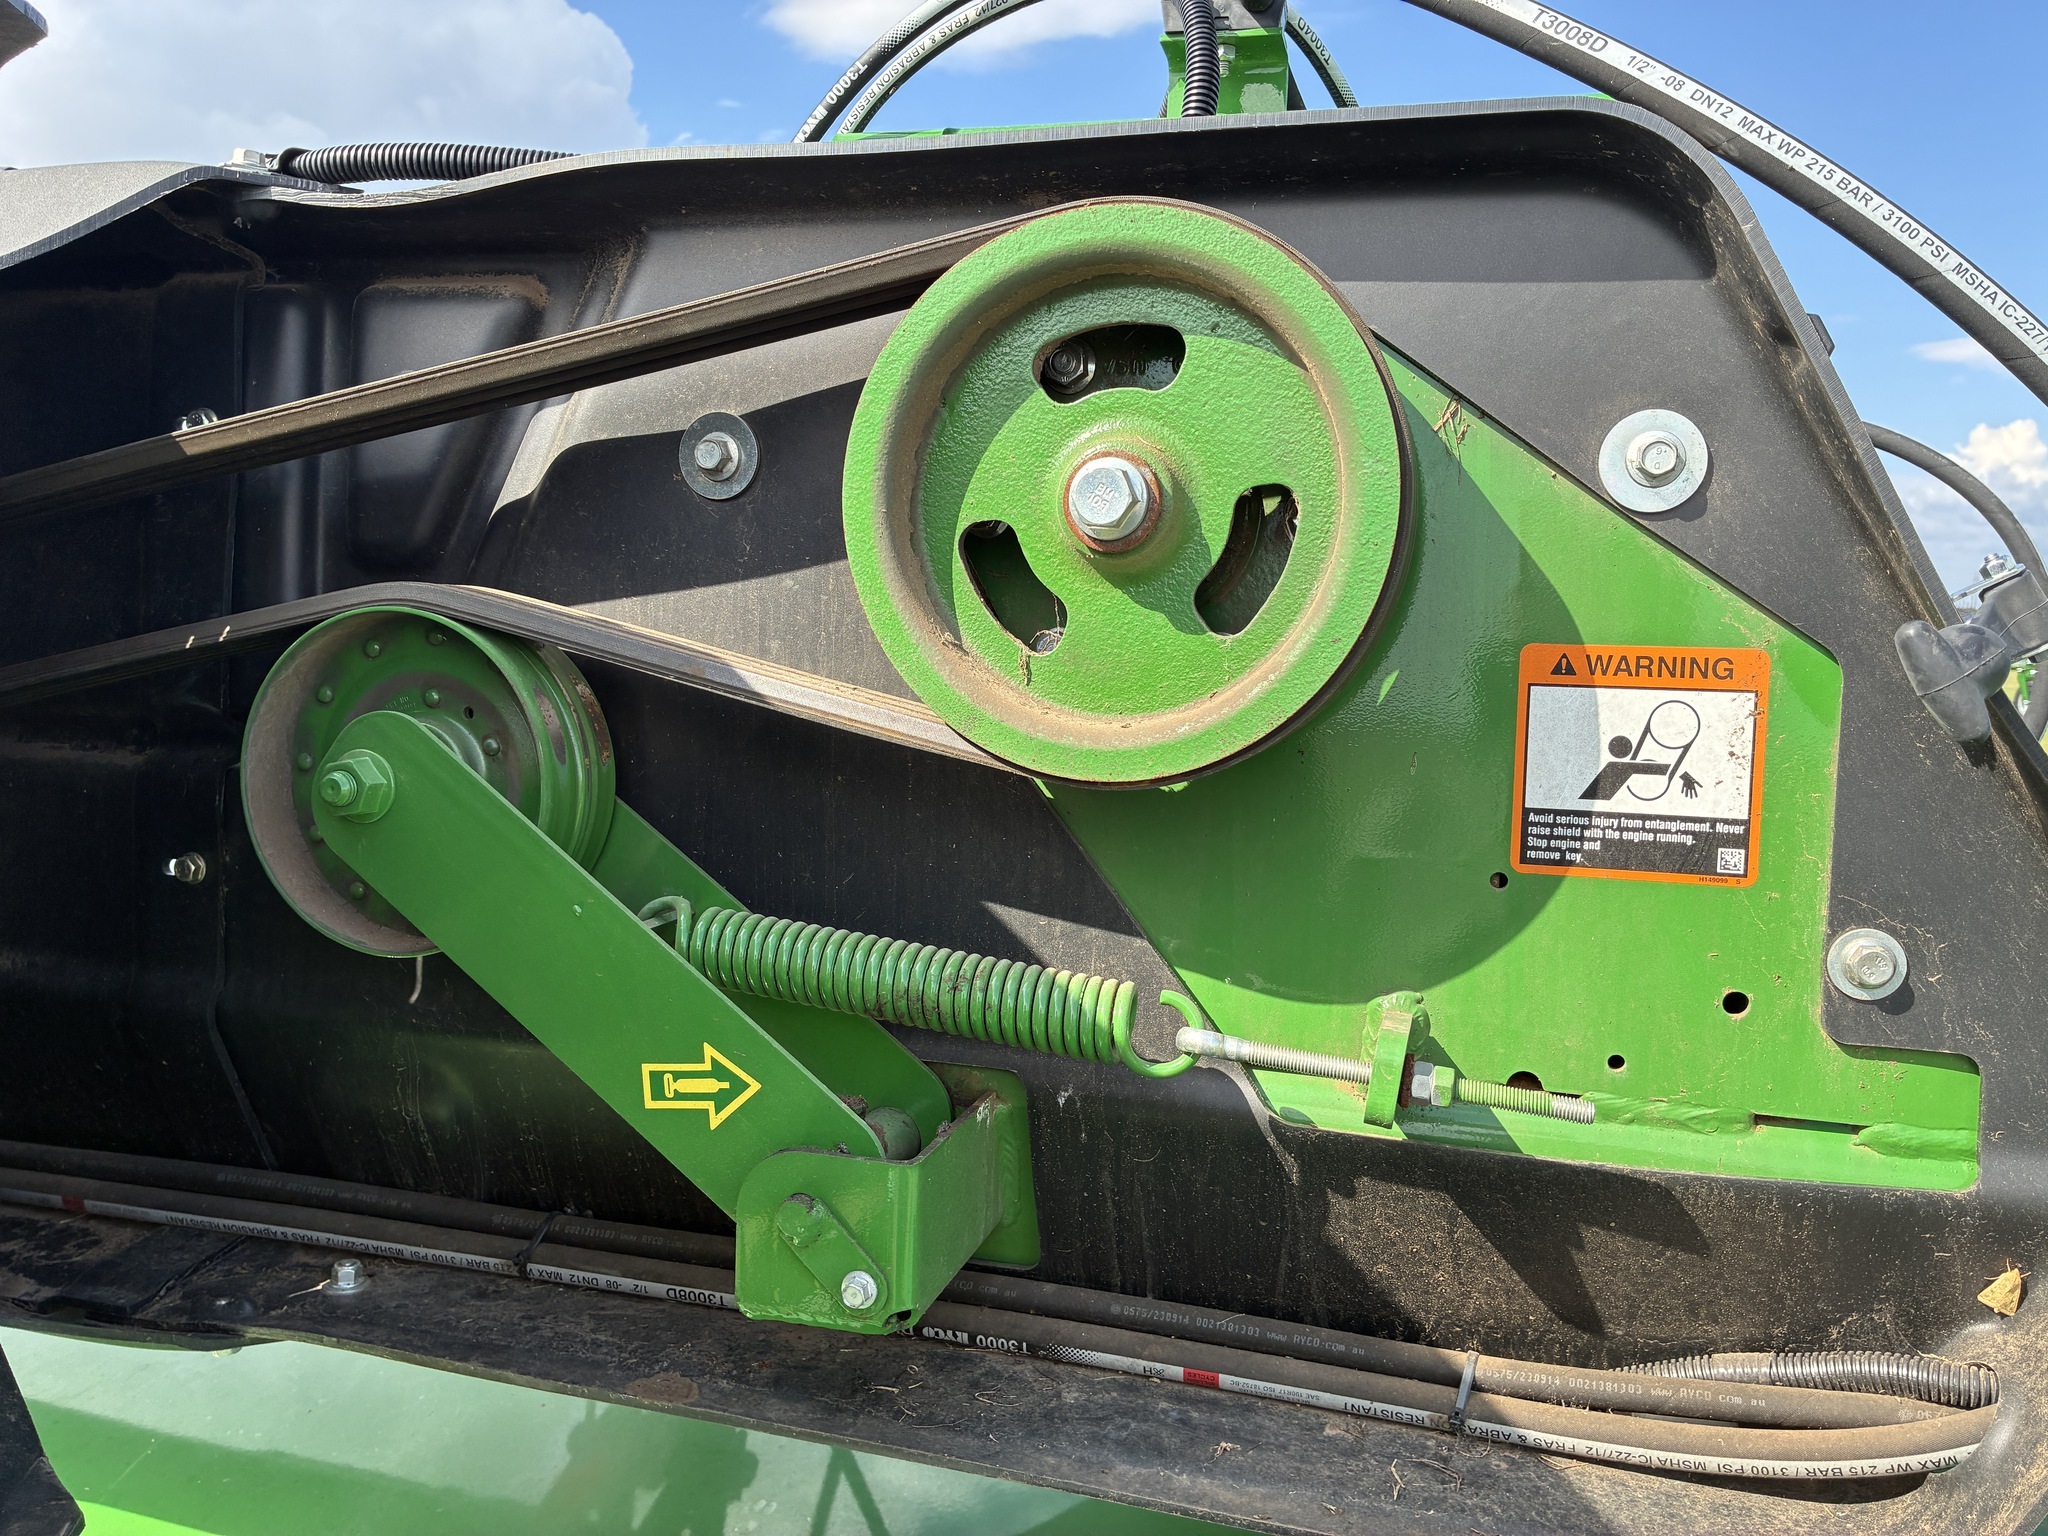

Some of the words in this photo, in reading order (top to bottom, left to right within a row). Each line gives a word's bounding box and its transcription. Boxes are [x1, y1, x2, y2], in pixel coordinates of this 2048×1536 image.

[939, 13, 970, 38] FRAS
[929, 34, 937, 44] &
[1297, 16, 1331, 66] T3004D
[876, 40, 926, 92] ABRASION
[825, 60, 869, 105] T3000
[1532, 7, 1609, 53] T3008D
[1626, 54, 1657, 74] 1/2"
[1660, 74, 1686, 92] -08
[1689, 88, 1735, 119] DN12
[1737, 115, 1778, 145] MAX
[1777, 138, 1806, 160] WP
[1804, 157, 1837, 181] 215
[1836, 176, 1875, 208] BAR
[1881, 208, 1921, 241] 3100
[1920, 237, 1950, 263] PSI
[1952, 262, 1999, 305] MSHA
[1586, 654, 1734, 680] WARNING
[1528, 812, 1554, 824] Avoid
[1556, 814, 1590, 825] serious
[1592, 816, 1618, 829] injury
[1620, 817, 1642, 828] from
[1644, 819, 1713, 832] entanglement.
[1716, 822, 1745, 834] Never
[1527, 836, 1548, 849] Stop
[1550, 838, 1580, 850] engine
[1583, 840, 1601, 850] and
[1528, 826, 1550, 835] raise
[1552, 827, 1580, 836] shield
[1583, 828, 1603, 838] with
[1605, 829, 1620, 840] the
[1622, 830, 1654, 842] engine
[1656, 832, 1696, 846] running.
[1526, 850, 1560, 860] remove
[1565, 850, 1584, 863] key.
[371, 1244, 404, 1257] MSHA
[410, 1250, 429, 1262] PSI
[432, 1252, 456, 1264] 3100
[466, 1258, 490, 1270] BAR
[536, 1269, 563, 1281] MAX
[569, 1273, 600, 1287] DN12
[606, 1280, 622, 1290] -08
[666, 1287, 728, 1308] T3008D
[1124, 1306, 1190, 1324] 0575/230914
[1196, 1316, 1260, 1337] 0021381303
[922, 1326, 969, 1345] RYCO
[976, 1334, 1031, 1355] T3000
[1486, 1369, 1560, 1386] 0575/230914
[1568, 1378, 1642, 1394] 0021381303
[1262, 1386, 1276, 1394] ISO
[1344, 1402, 1425, 1425] RESISTANT
[1516, 1434, 1528, 1444] &
[1533, 1438, 1576, 1452] FRAS
[1656, 1456, 1707, 1471] MSHA
[1717, 1462, 1745, 1475] PSI
[1885, 1462, 1914, 1474] WP
[1917, 1455, 1960, 1470] MAX
[1750, 1465, 1789, 1477] 3100
[1804, 1467, 1844, 1478] BAR
[1849, 1465, 1880, 1476] 215
